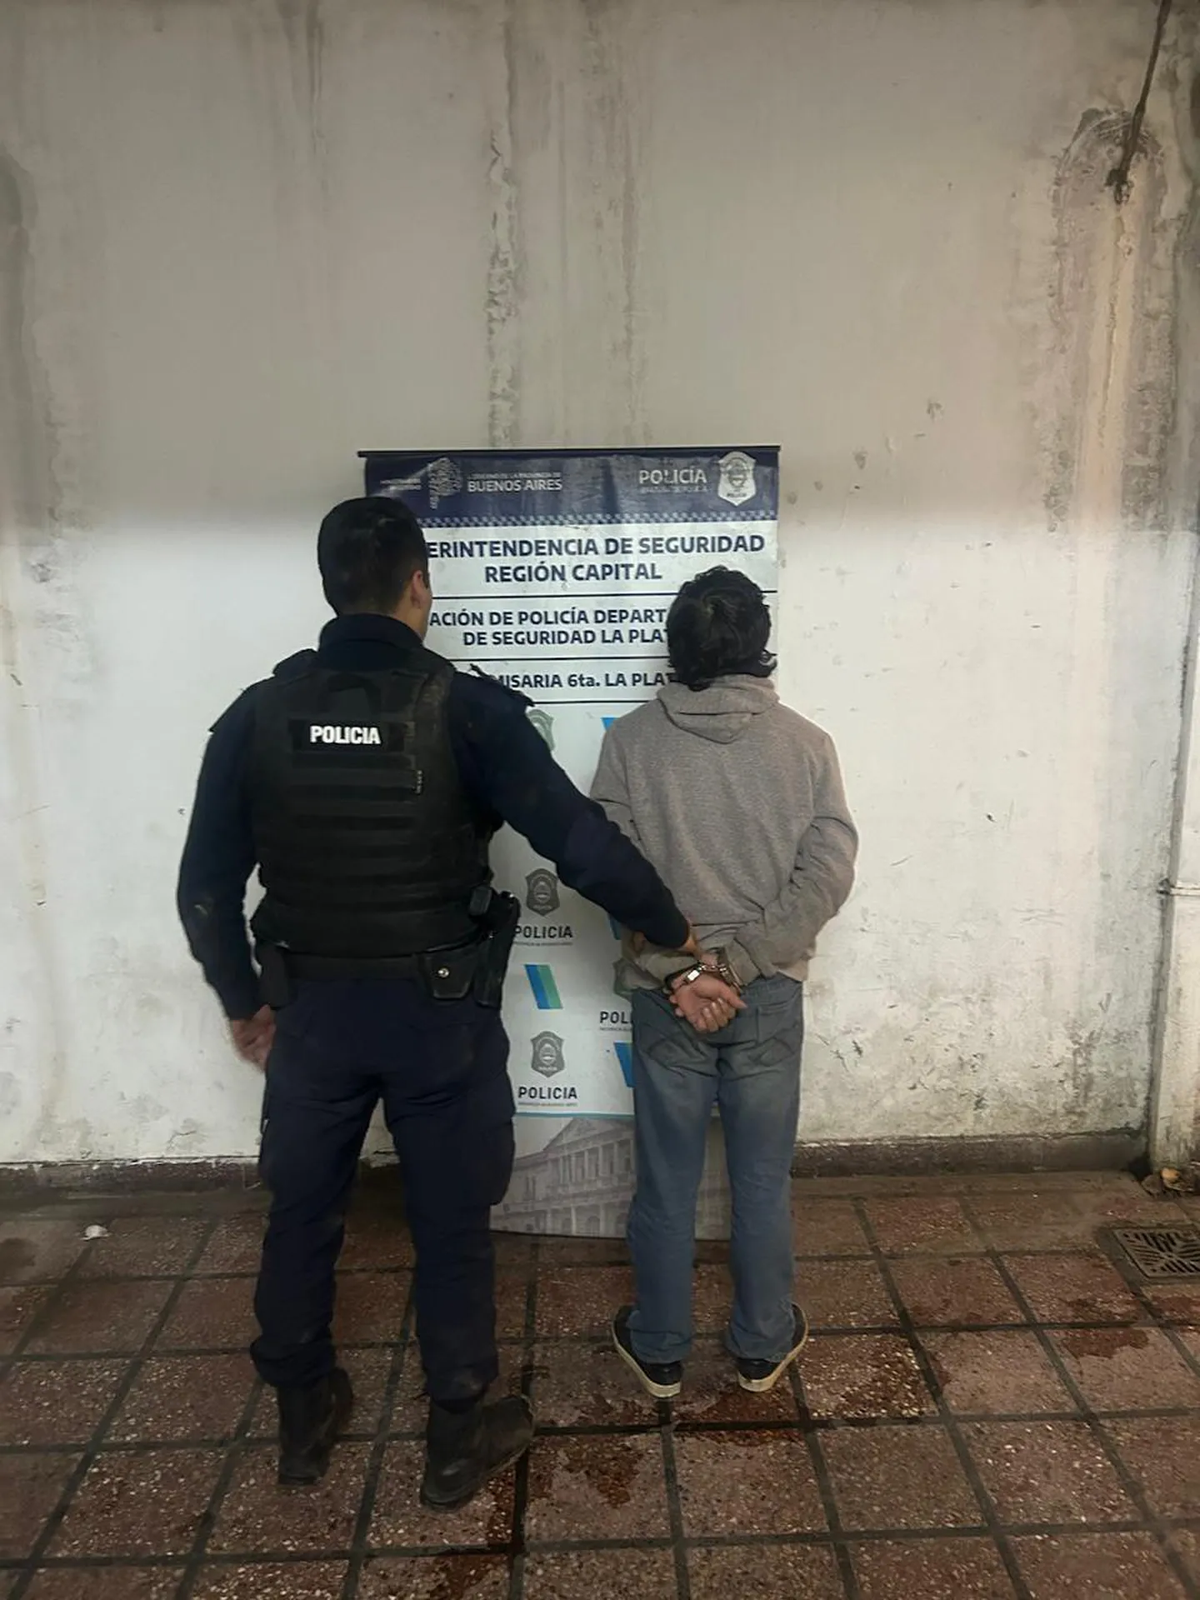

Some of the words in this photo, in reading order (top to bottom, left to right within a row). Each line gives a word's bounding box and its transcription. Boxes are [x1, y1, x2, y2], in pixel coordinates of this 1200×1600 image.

[467, 479, 522, 493] BUENOS
[524, 478, 563, 491] AIRES
[427, 538, 598, 558] ERINTENDENCIA
[605, 538, 633, 554] DE
[638, 535, 765, 553] SEGURIDAD
[485, 561, 565, 582] REGIÓN
[572, 562, 662, 581] CAPITAL
[429, 608, 484, 626] ACIÓN
[489, 611, 514, 625] DE
[518, 606, 589, 625] POLICÍA
[594, 609, 667, 623] DEPART
[463, 632, 488, 645] DE
[492, 630, 596, 645] SEGURIDAD
[601, 629, 624, 643] LA
[567, 674, 600, 687] 6ta.
[604, 673, 627, 686] LA
[310, 725, 381, 745] POLICIA
[514, 925, 573, 939] POLICIA
[600, 1011, 632, 1024] POL
[518, 1086, 578, 1100] POLICIA
